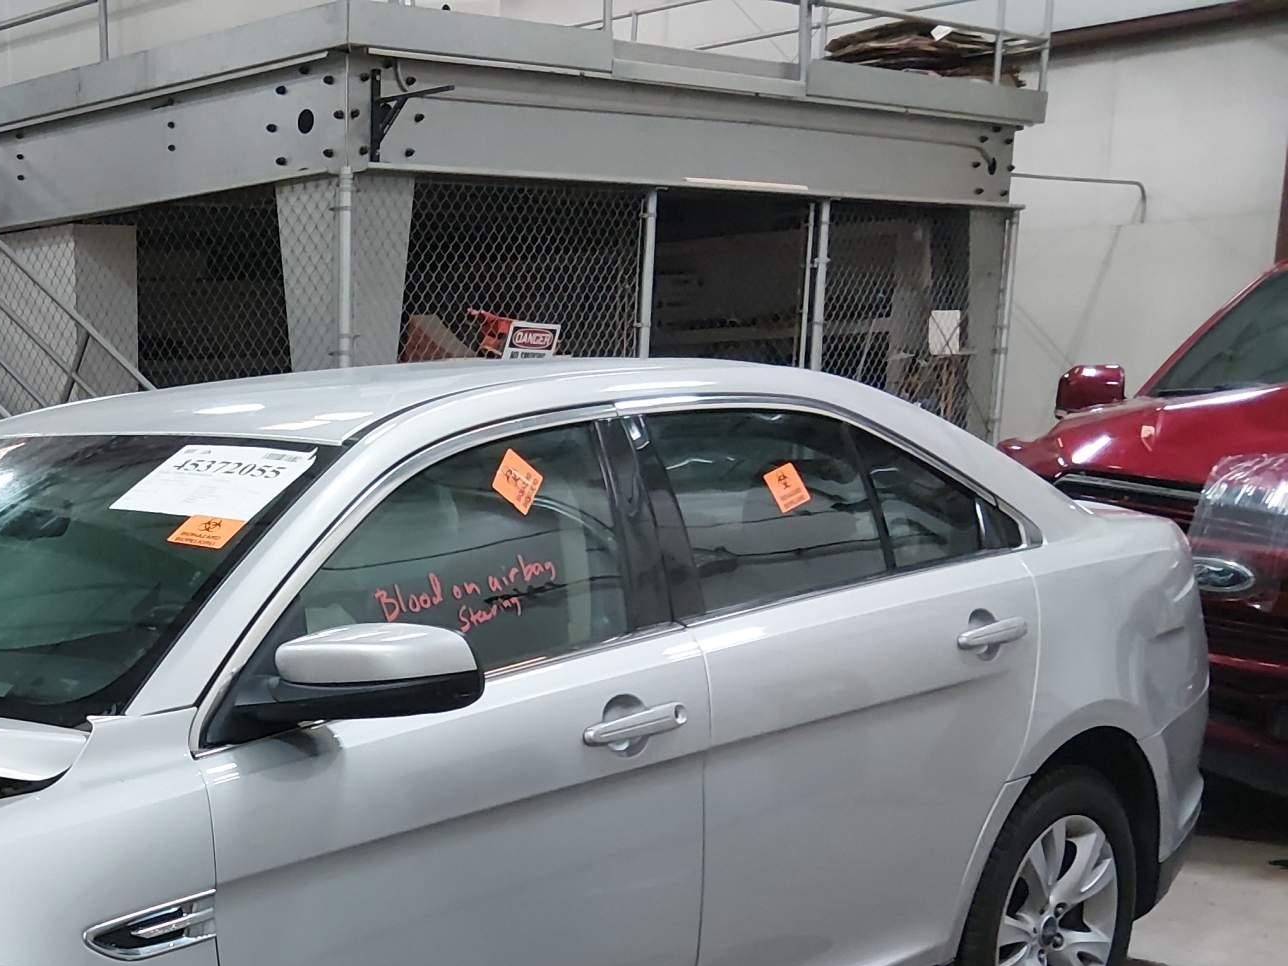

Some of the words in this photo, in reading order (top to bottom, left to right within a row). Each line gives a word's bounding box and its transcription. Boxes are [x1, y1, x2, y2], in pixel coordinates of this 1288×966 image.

[516, 332, 551, 345] DANGER
[173, 458, 287, 479] 45372055
[374, 572, 444, 623] Blood
[452, 580, 481, 600] on
[488, 553, 556, 591] airbag
